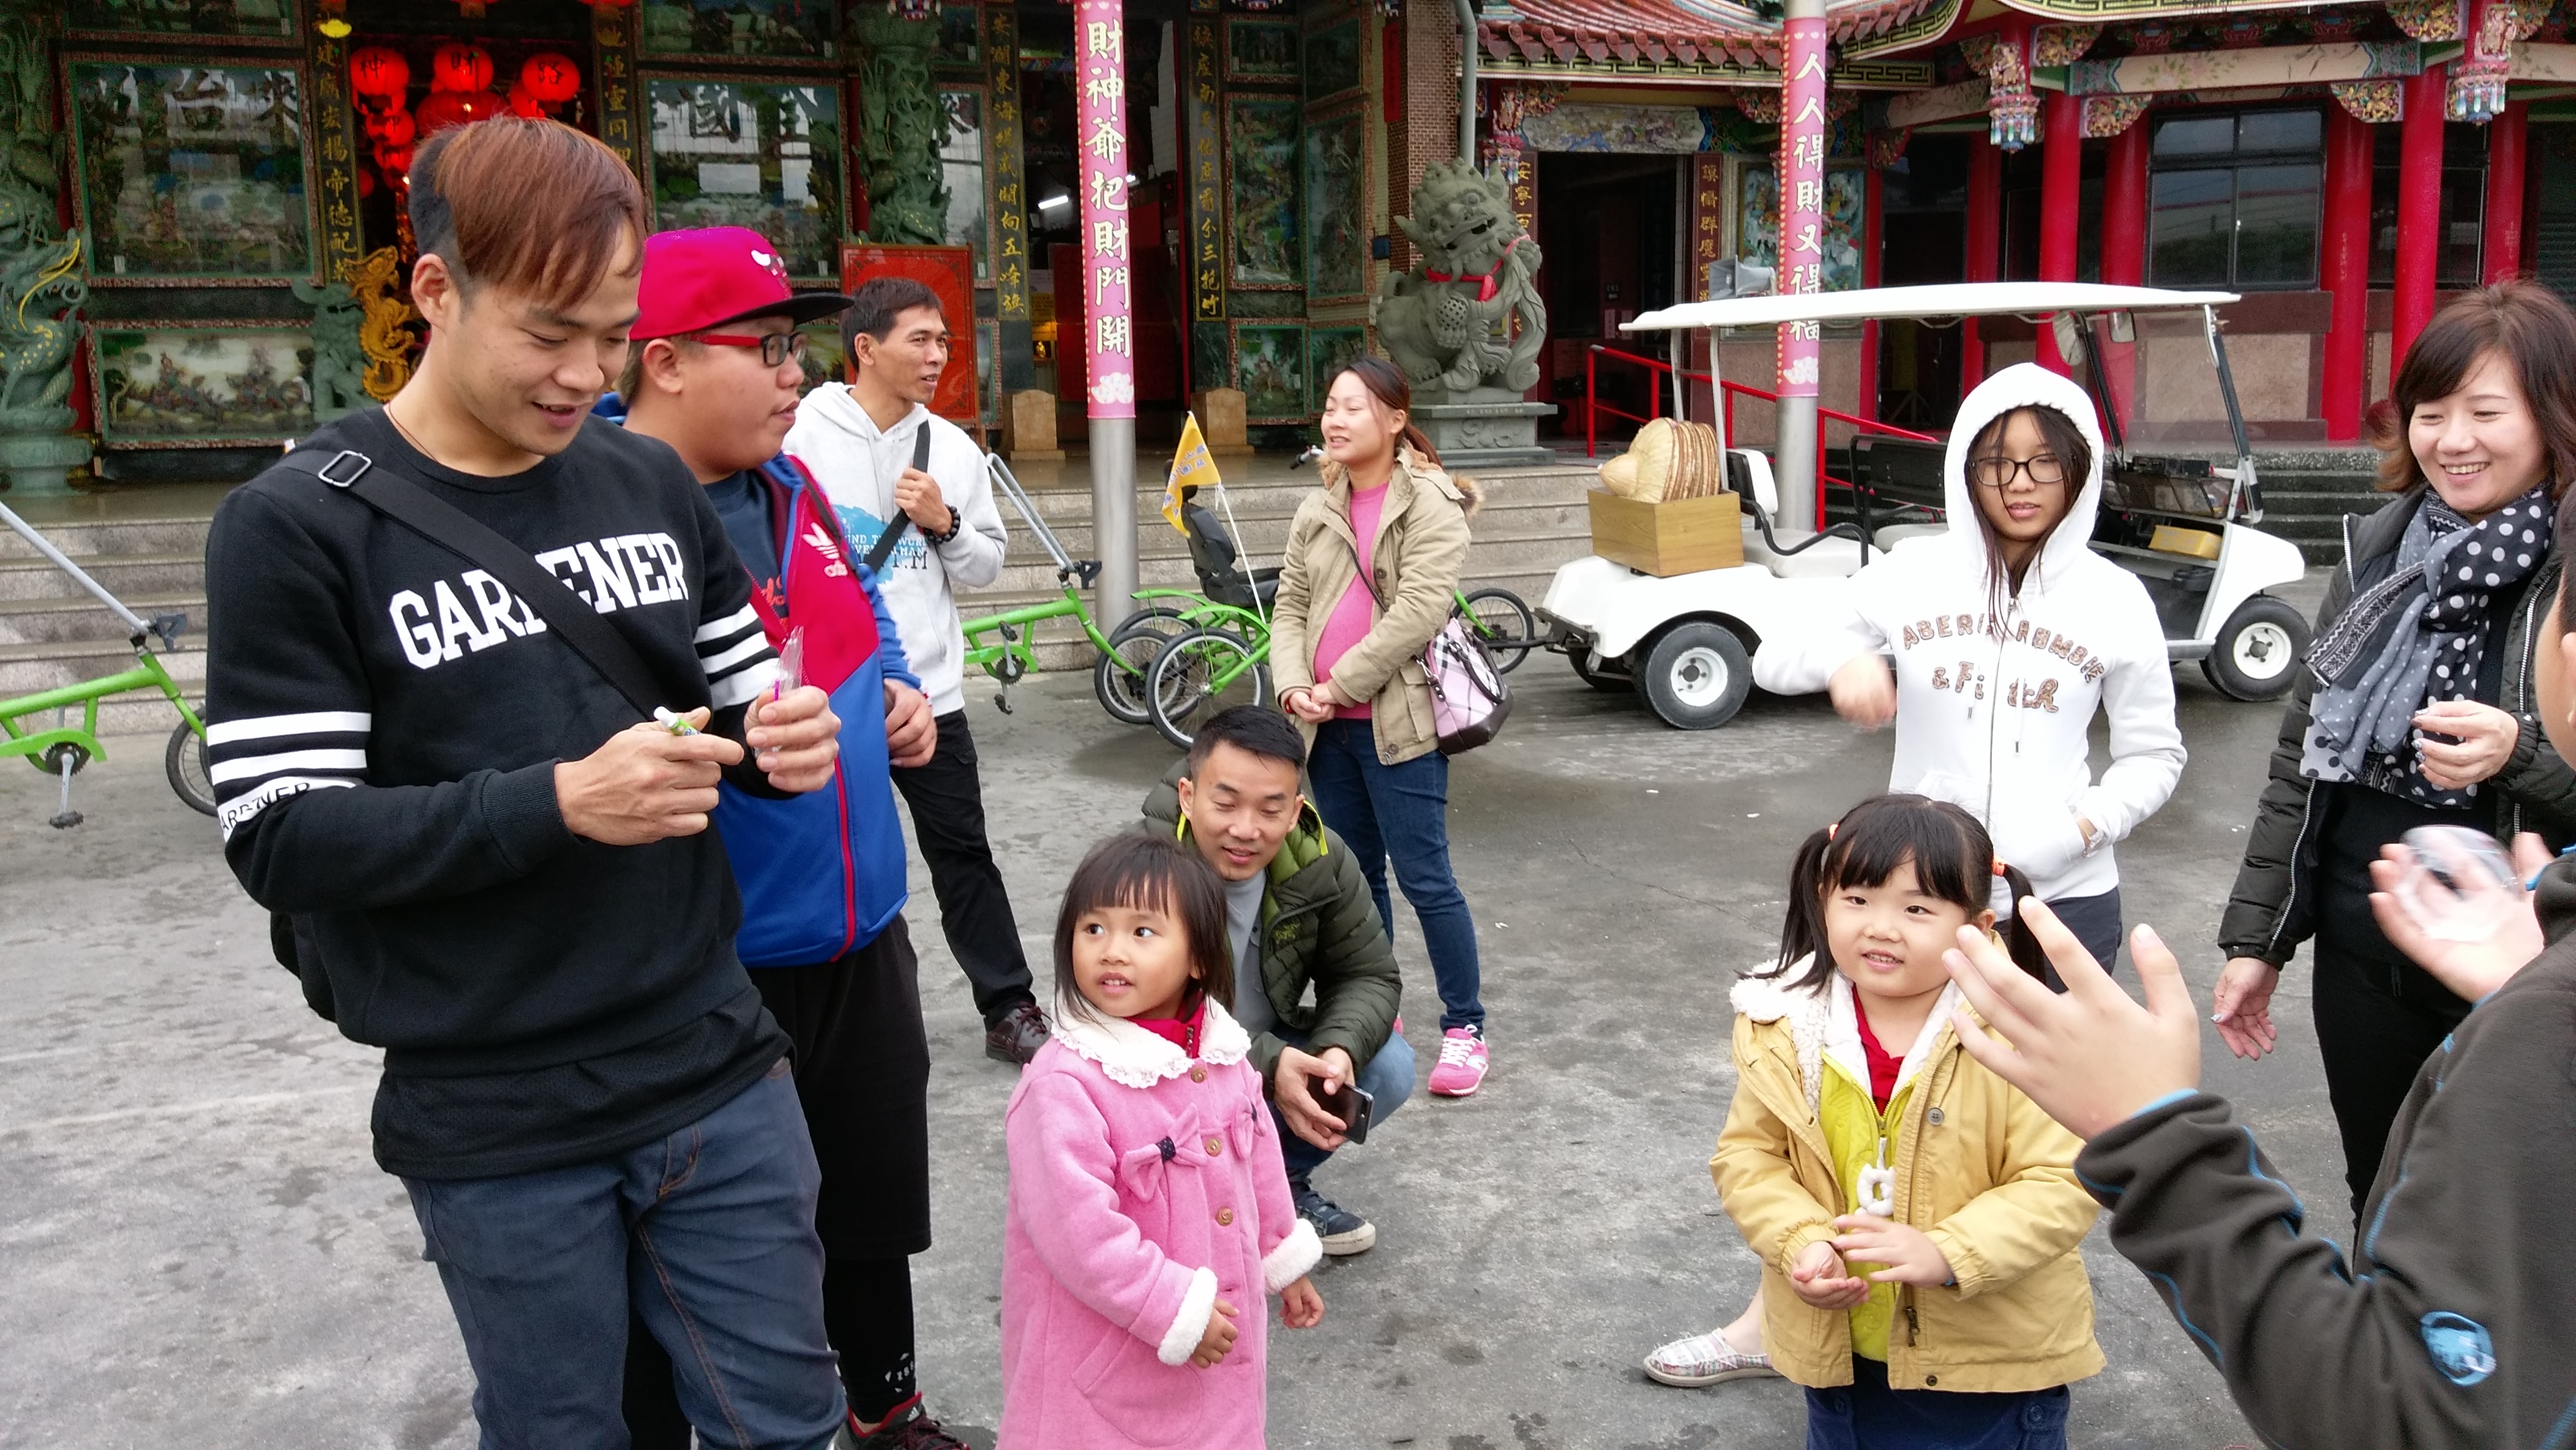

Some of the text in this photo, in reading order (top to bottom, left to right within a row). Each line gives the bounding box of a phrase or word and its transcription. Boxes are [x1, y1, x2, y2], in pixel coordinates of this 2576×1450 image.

[1085, 18, 1133, 359] 財神爺把財門開
[1789, 51, 1825, 342] 人人得財又得福
[1932, 666, 1950, 689] &
